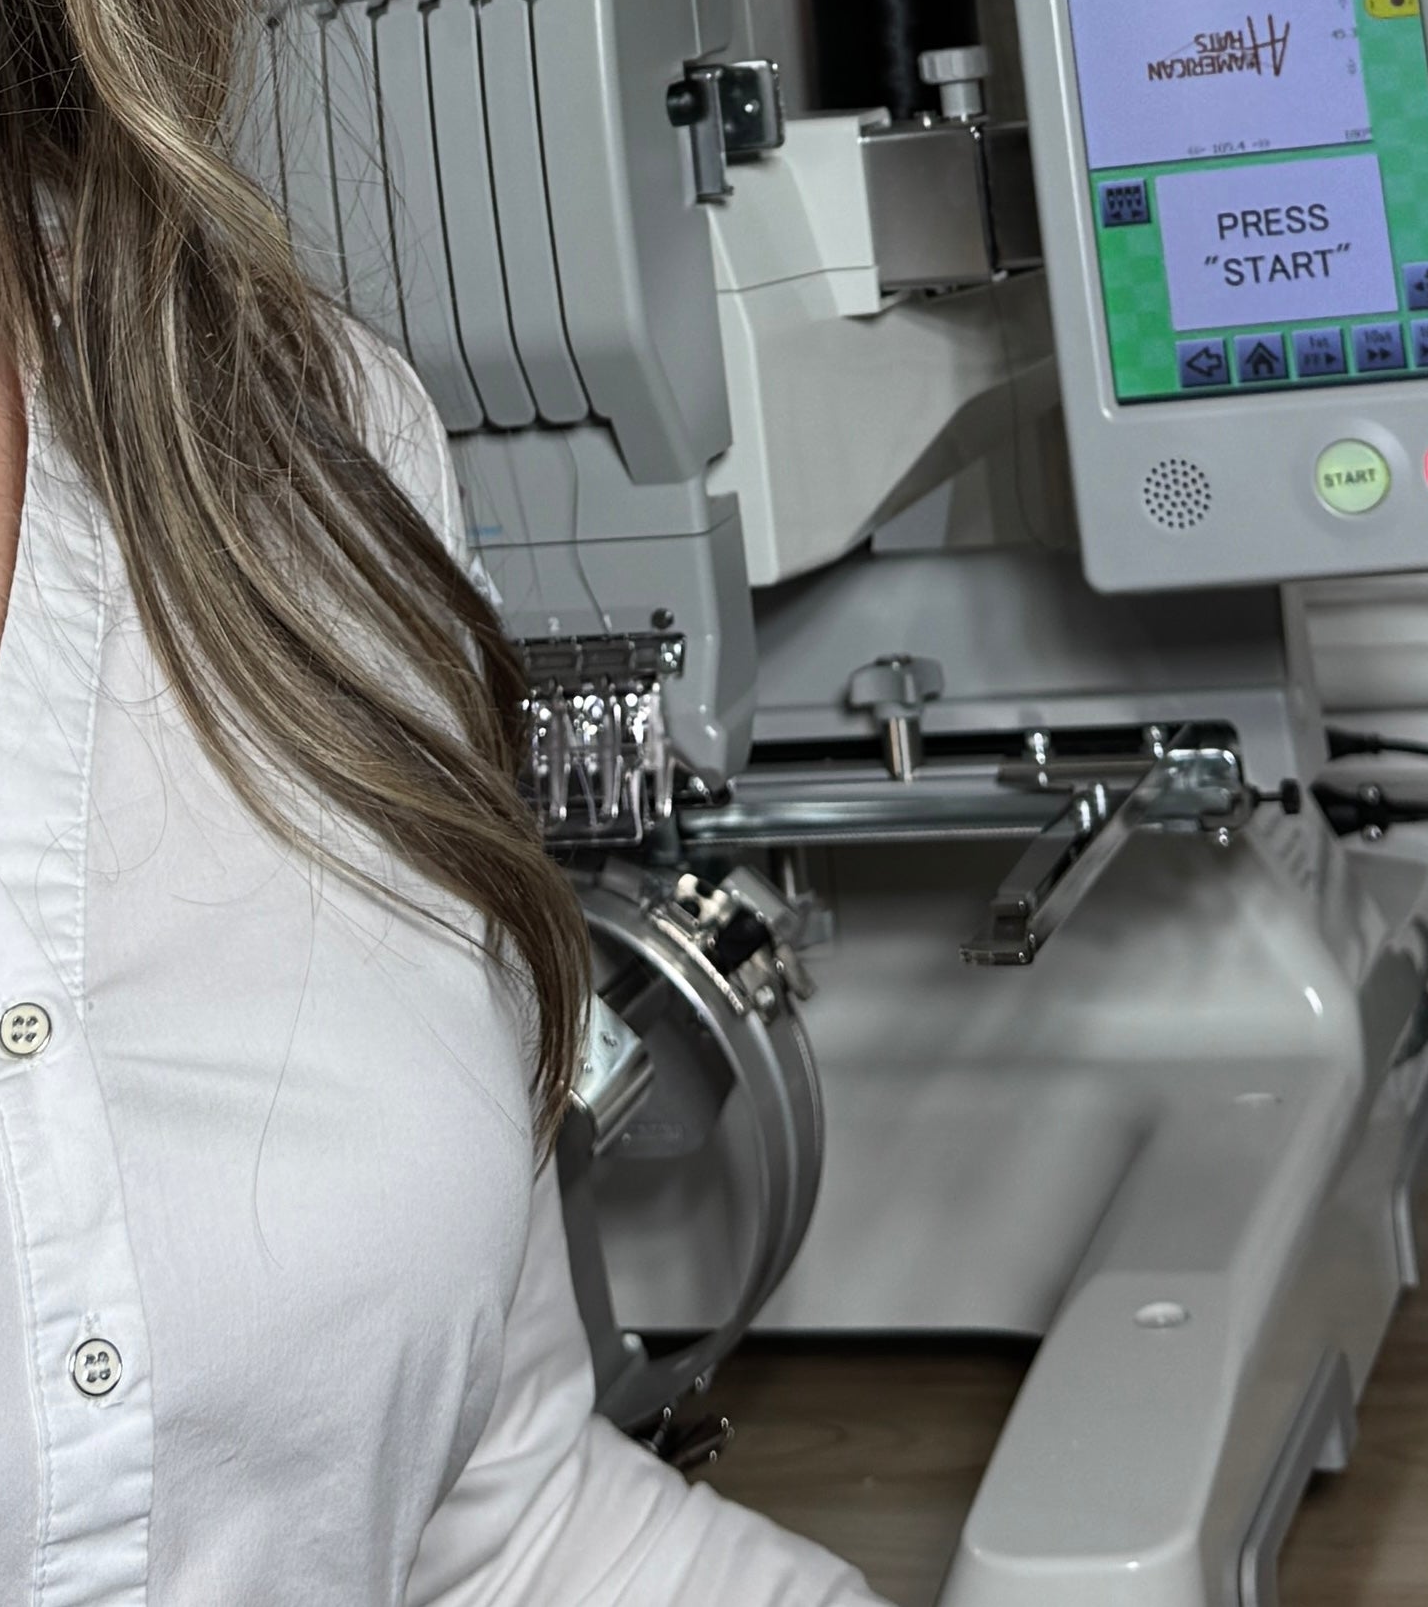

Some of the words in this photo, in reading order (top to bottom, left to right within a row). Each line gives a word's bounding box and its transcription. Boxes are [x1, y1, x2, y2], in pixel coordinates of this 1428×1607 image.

[1194, 30, 1244, 53] HATS
[1147, 54, 1248, 80] AMERICAN
[1217, 203, 1330, 241] PRESS
[1204, 242, 1352, 287] "START"
[1323, 468, 1377, 488] START
